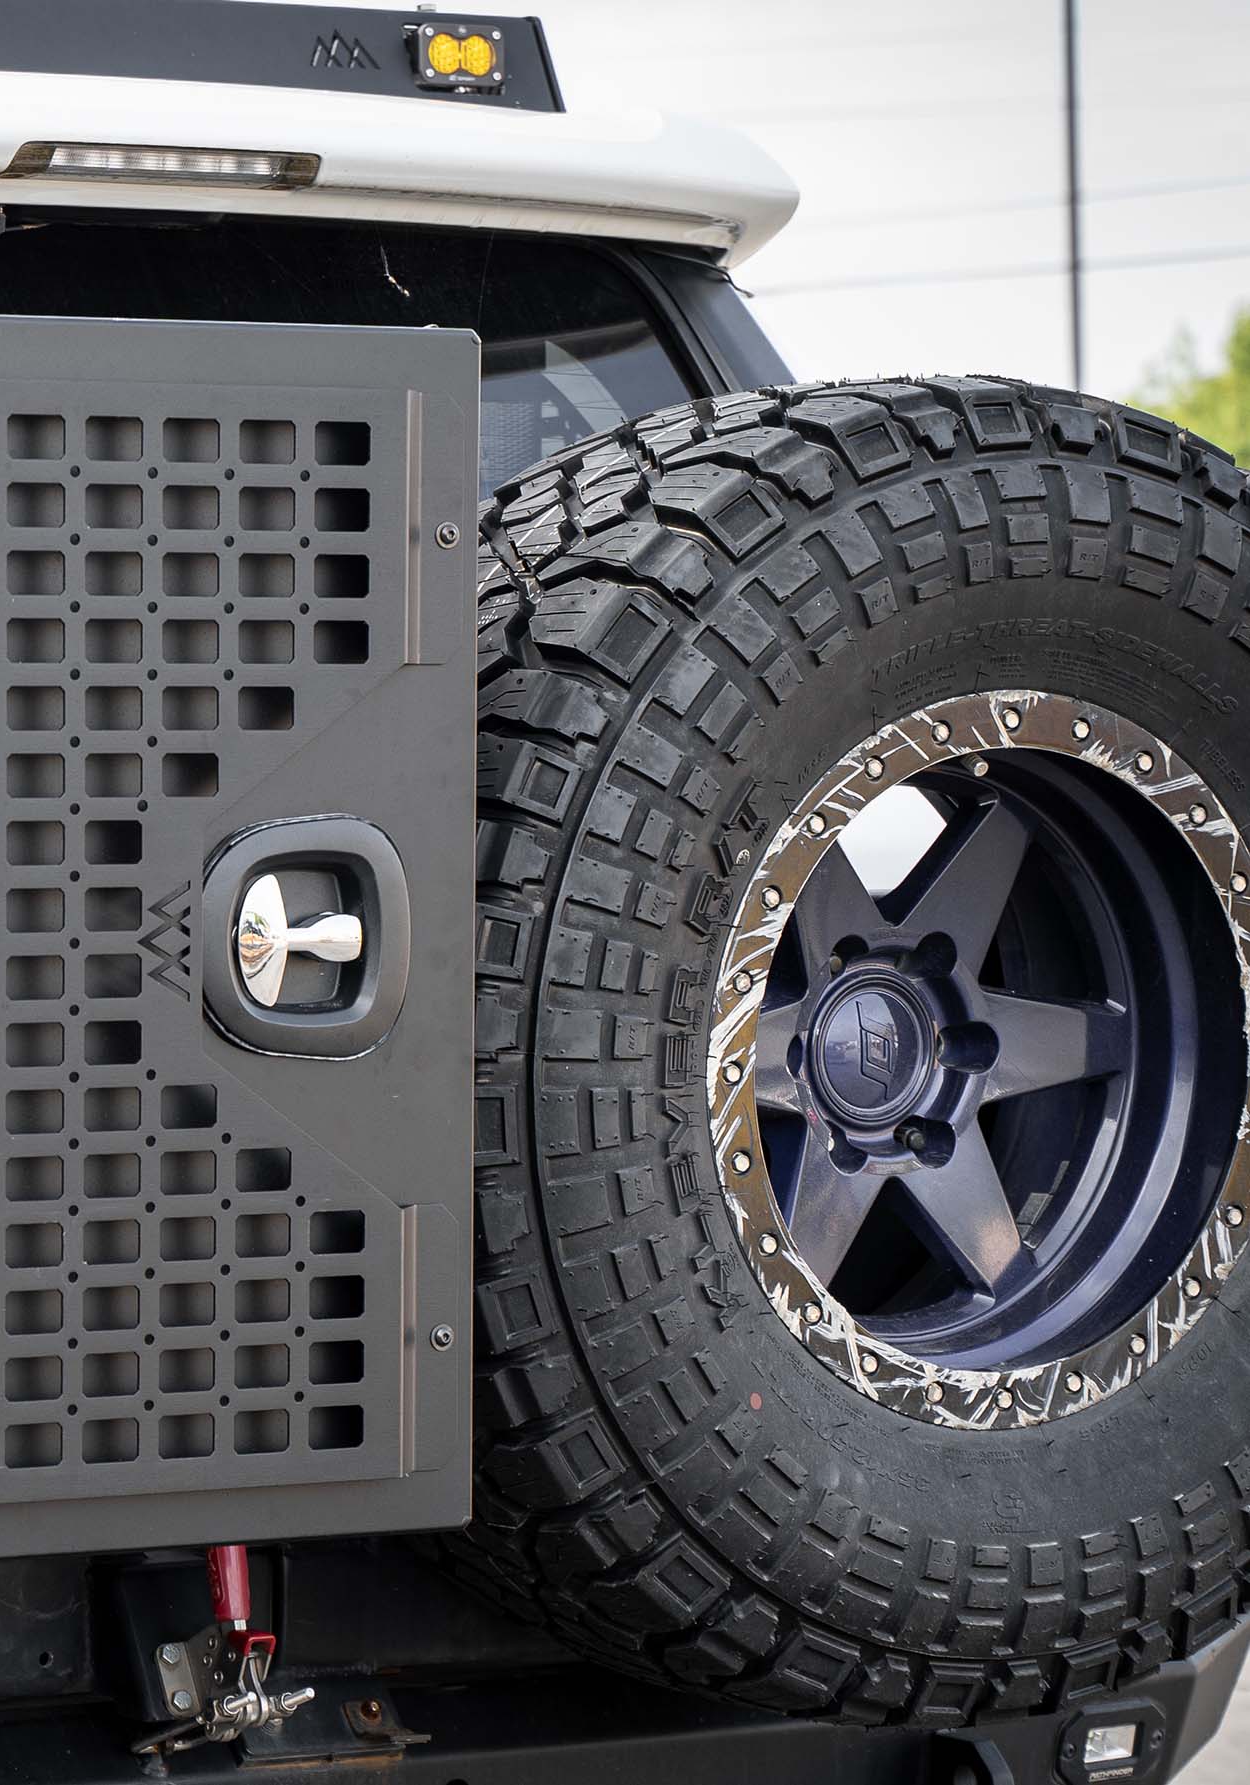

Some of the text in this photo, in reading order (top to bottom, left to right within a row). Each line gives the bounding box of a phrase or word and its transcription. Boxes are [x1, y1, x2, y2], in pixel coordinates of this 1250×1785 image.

[971, 557, 992, 569] R/T
[1079, 552, 1099, 562] R/T
[870, 592, 890, 610] R/T
[775, 666, 792, 689] R/T
[694, 778, 710, 803] R/T
[650, 892, 662, 919] R/T
[627, 1024, 638, 1051] R/T
[634, 1177, 644, 1202] R/T
